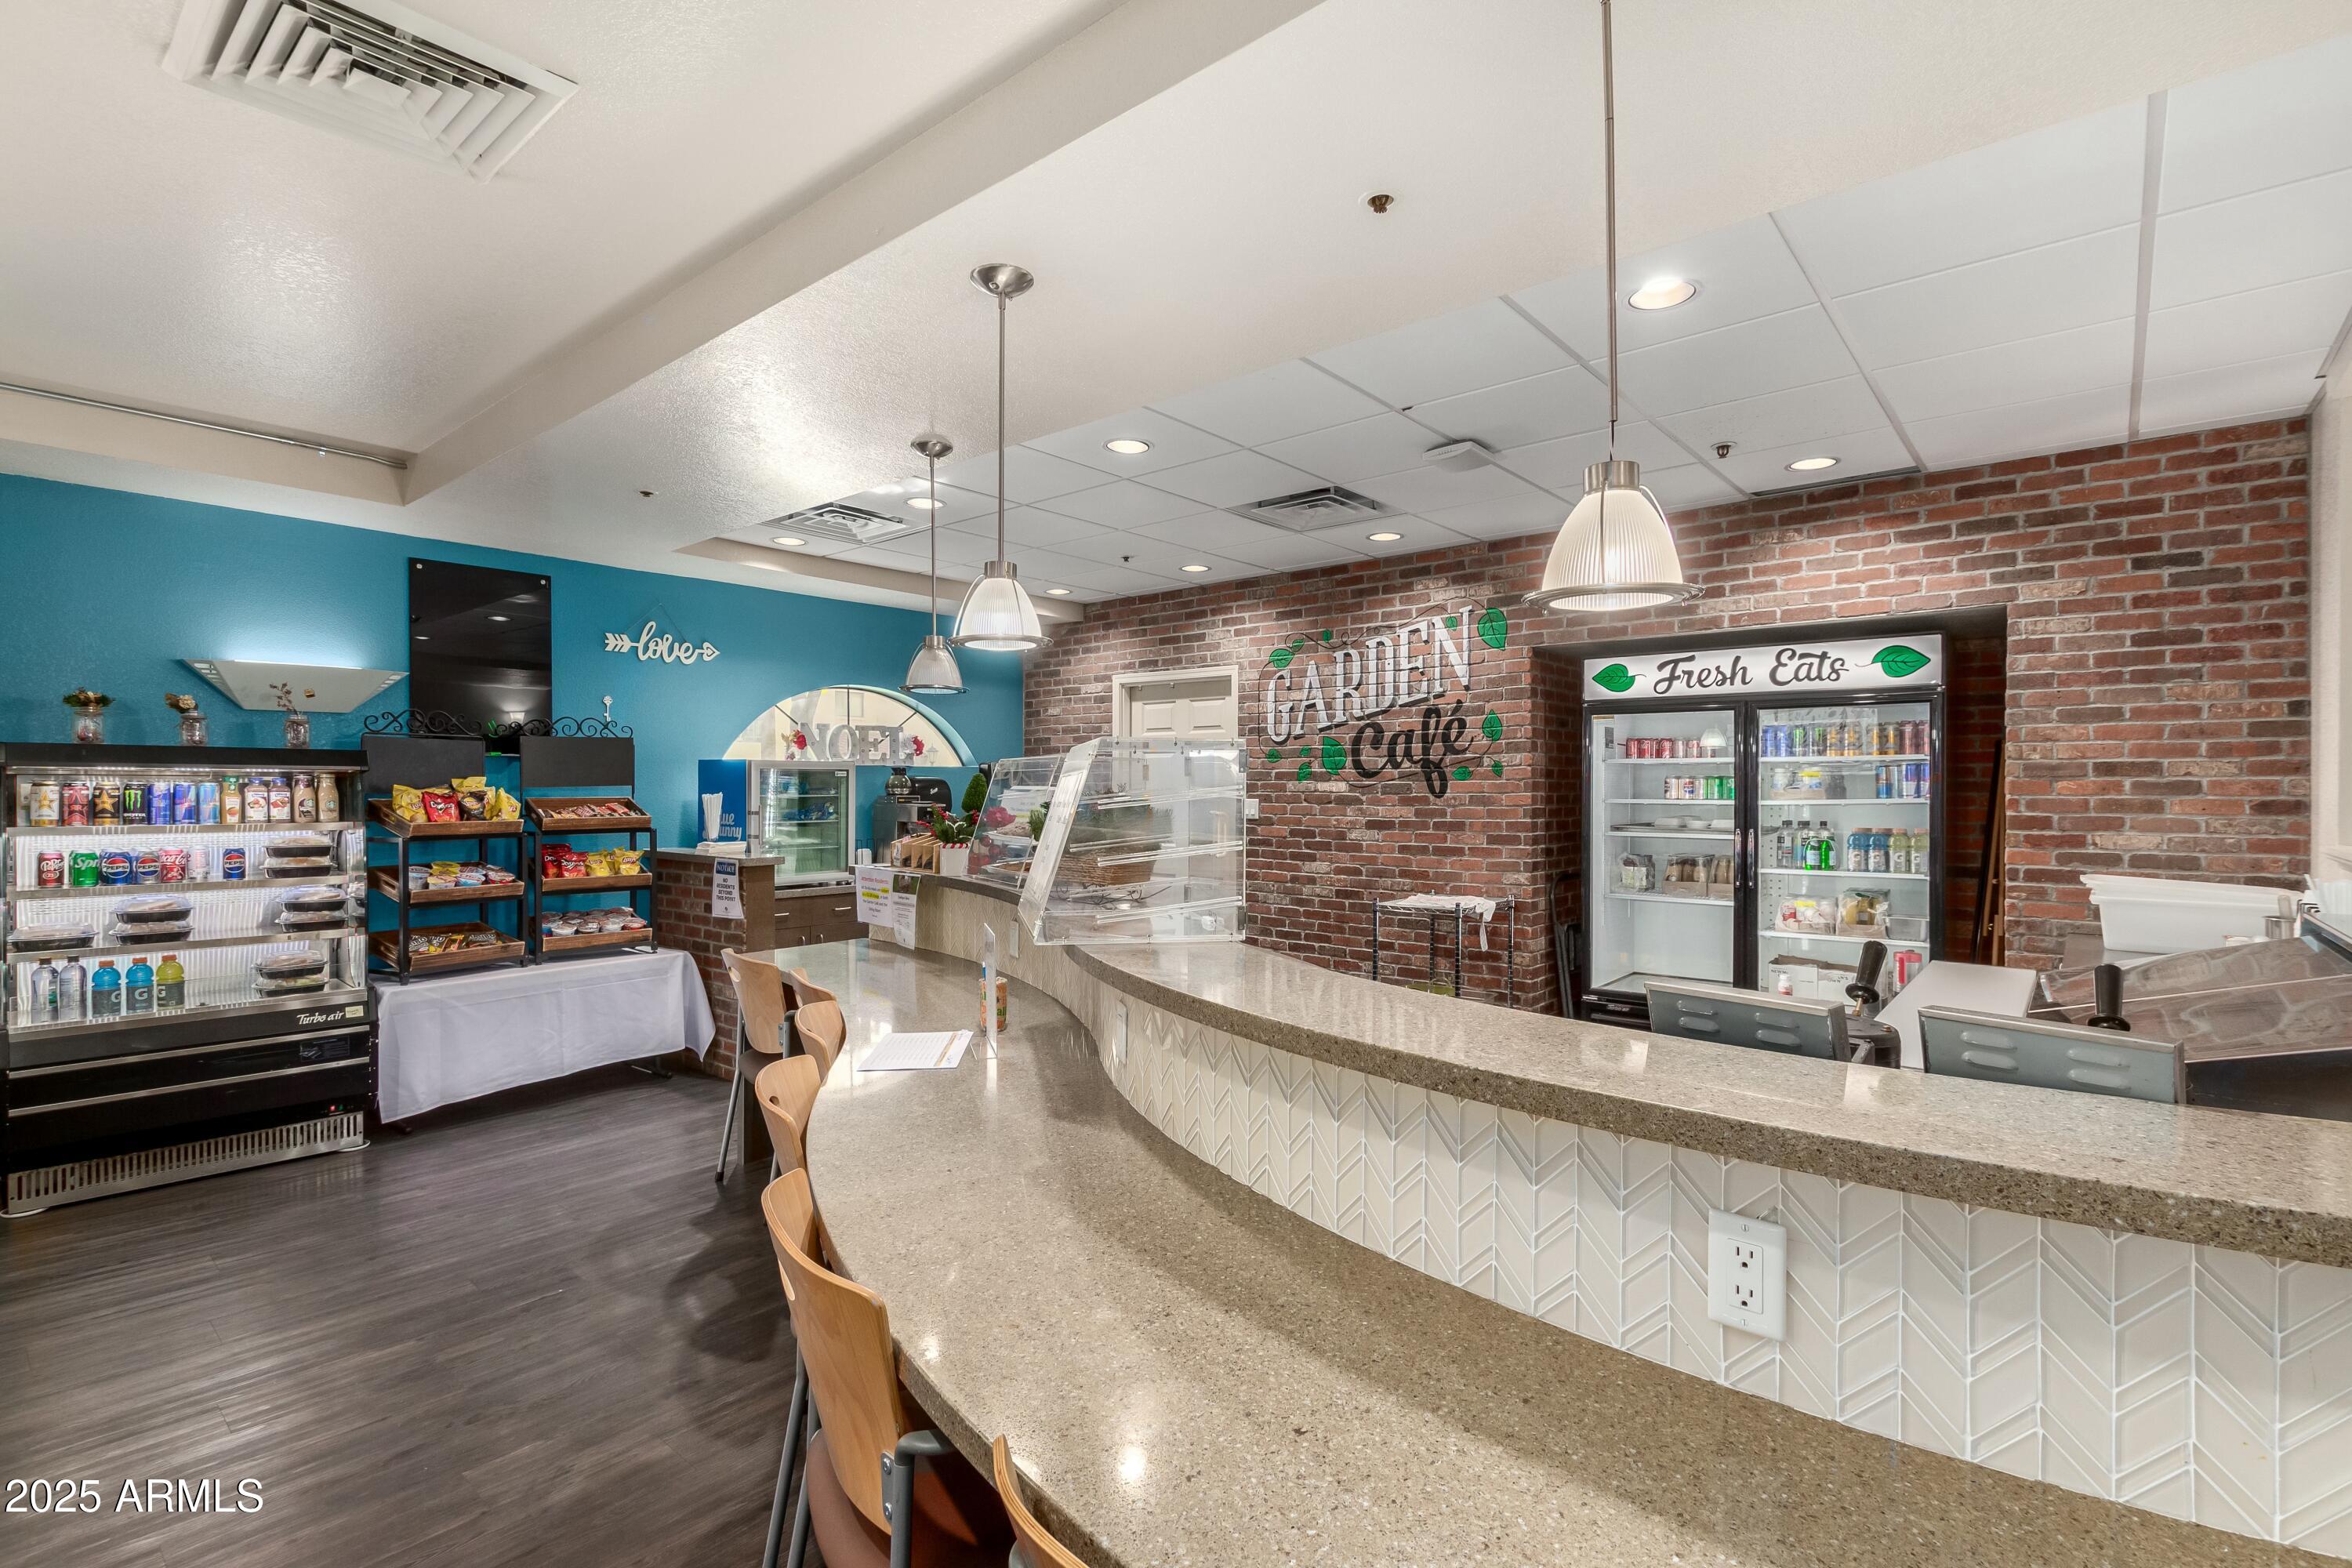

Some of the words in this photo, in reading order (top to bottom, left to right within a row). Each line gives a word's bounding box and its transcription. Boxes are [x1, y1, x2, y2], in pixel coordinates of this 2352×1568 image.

[637, 621, 700, 665] love
[1266, 605, 1473, 744] GARDEN
[1653, 654, 1753, 695] Fresh
[1769, 648, 1849, 687] Eats
[800, 722, 914, 766] NOEL
[1351, 699, 1474, 798] Café
[717, 864, 735, 873] NOTICE
[135, 988, 147, 1000] G
[296, 1012, 326, 1025] Turbo
[327, 1011, 345, 1021] air
